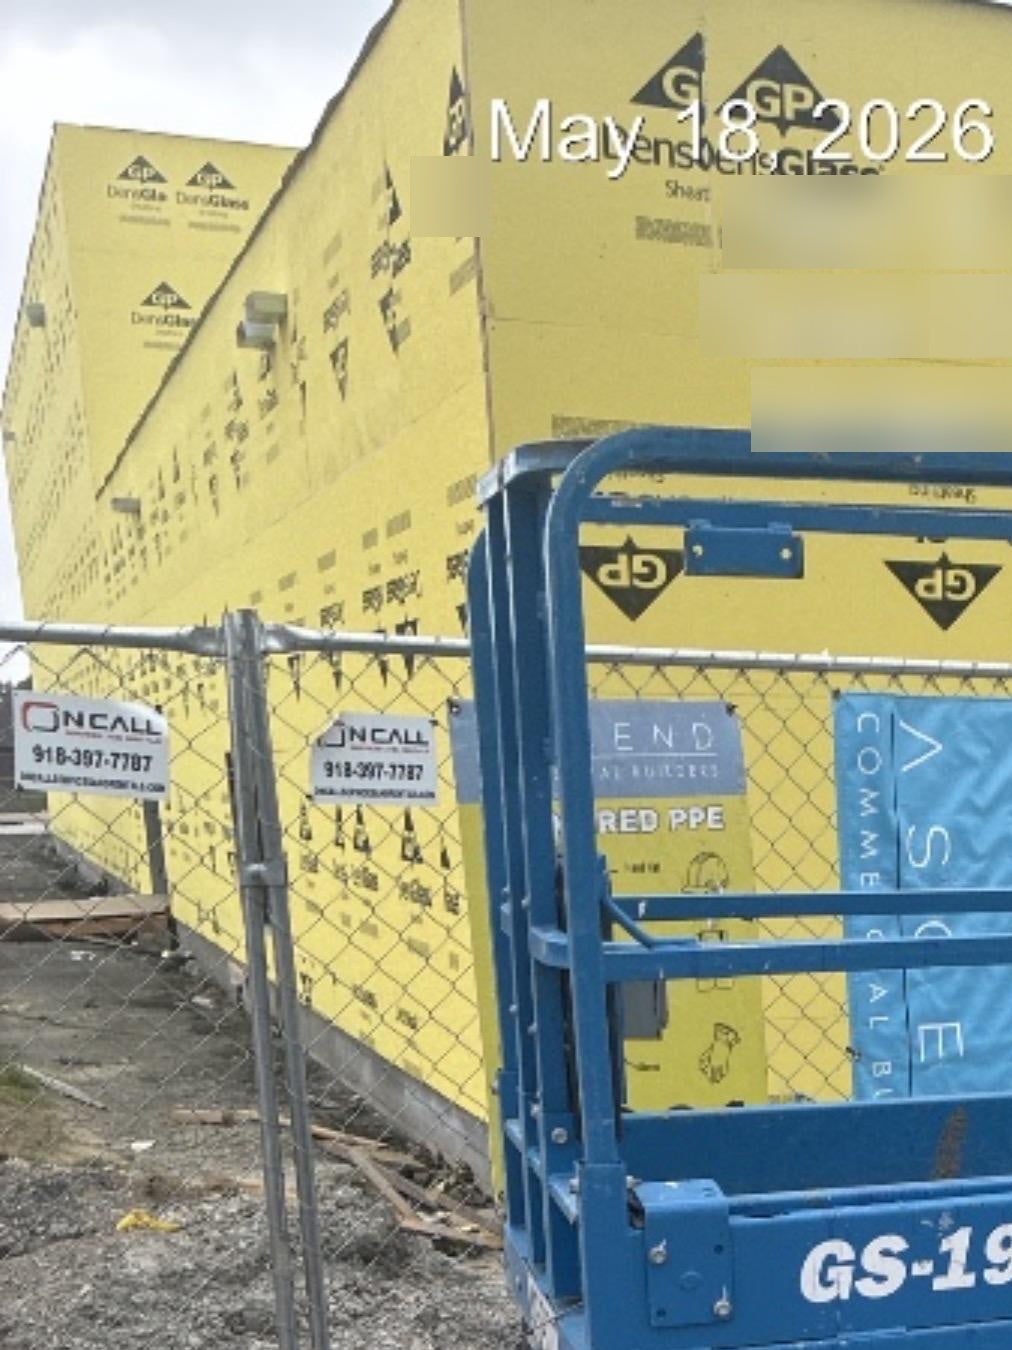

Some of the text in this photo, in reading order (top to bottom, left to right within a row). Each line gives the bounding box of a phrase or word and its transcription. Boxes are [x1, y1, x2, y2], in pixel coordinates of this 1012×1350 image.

[598, 553, 667, 589] GP
[914, 565, 977, 600] GP
[669, 804, 725, 832] PPE
